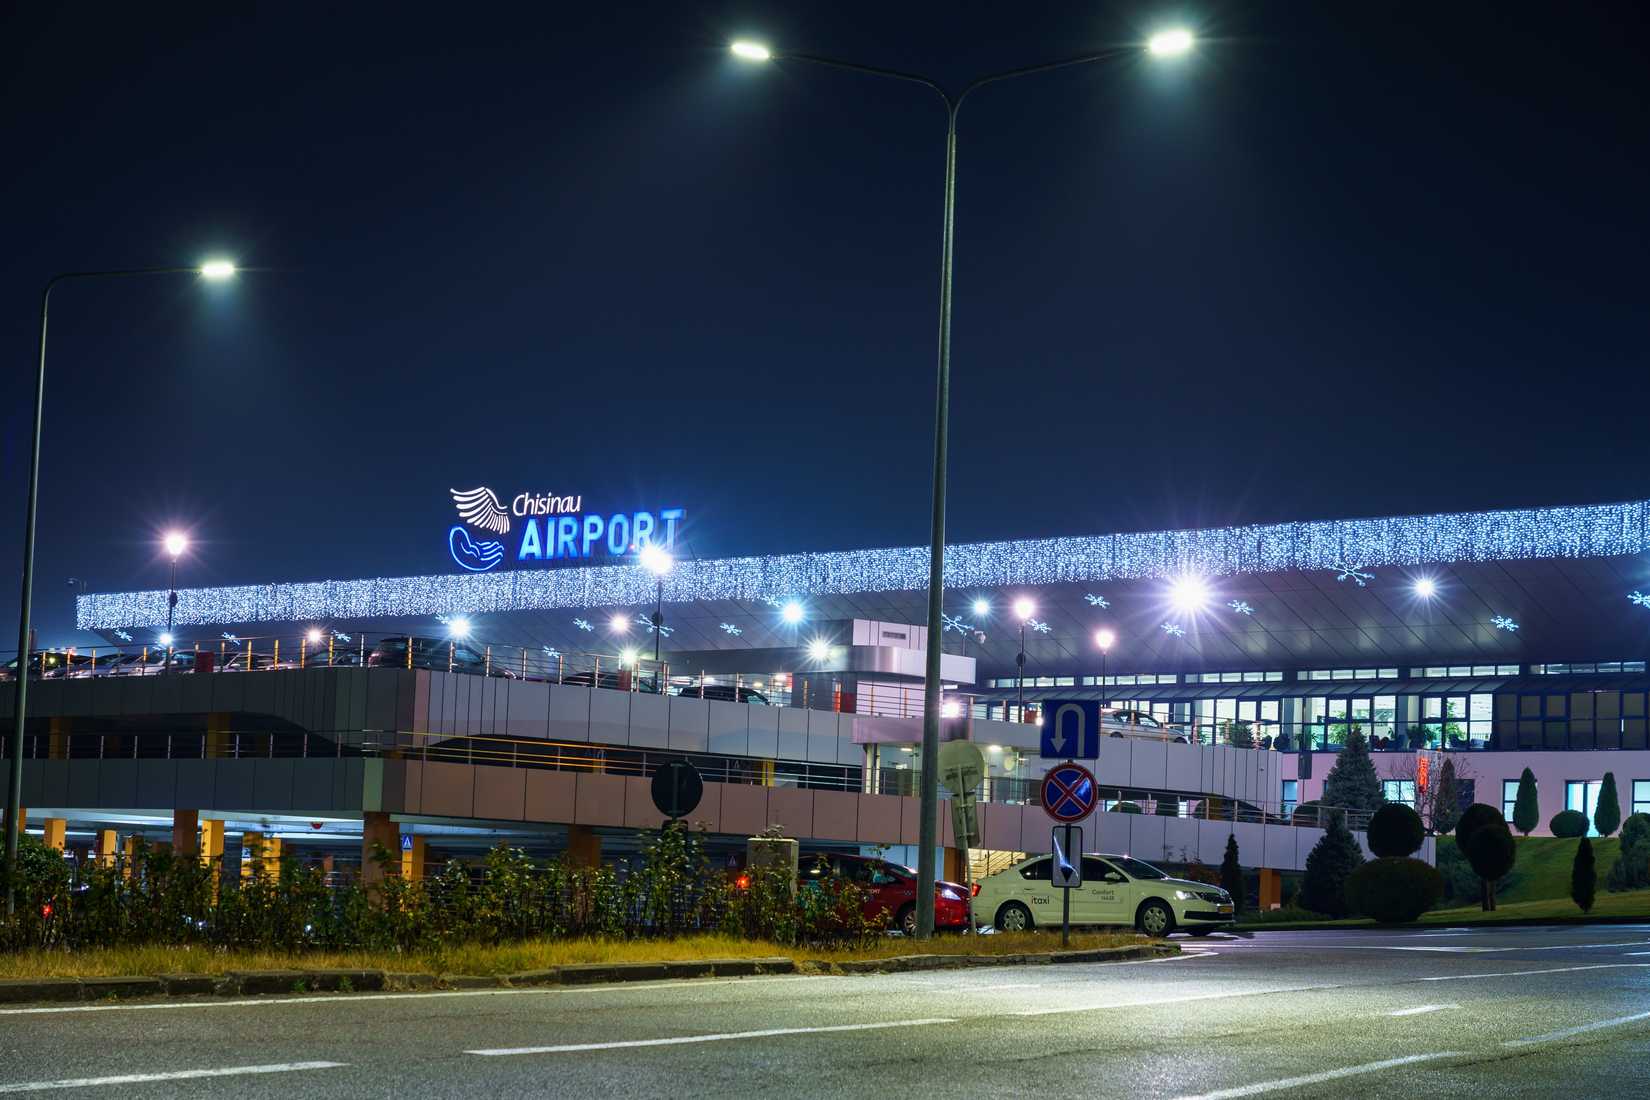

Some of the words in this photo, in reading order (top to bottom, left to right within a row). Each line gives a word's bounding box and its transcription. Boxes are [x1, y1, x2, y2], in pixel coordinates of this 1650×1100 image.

[512, 492, 582, 516] Chisinau
[518, 509, 685, 560] AIRPORT
[1031, 895, 1050, 905] itaxi
